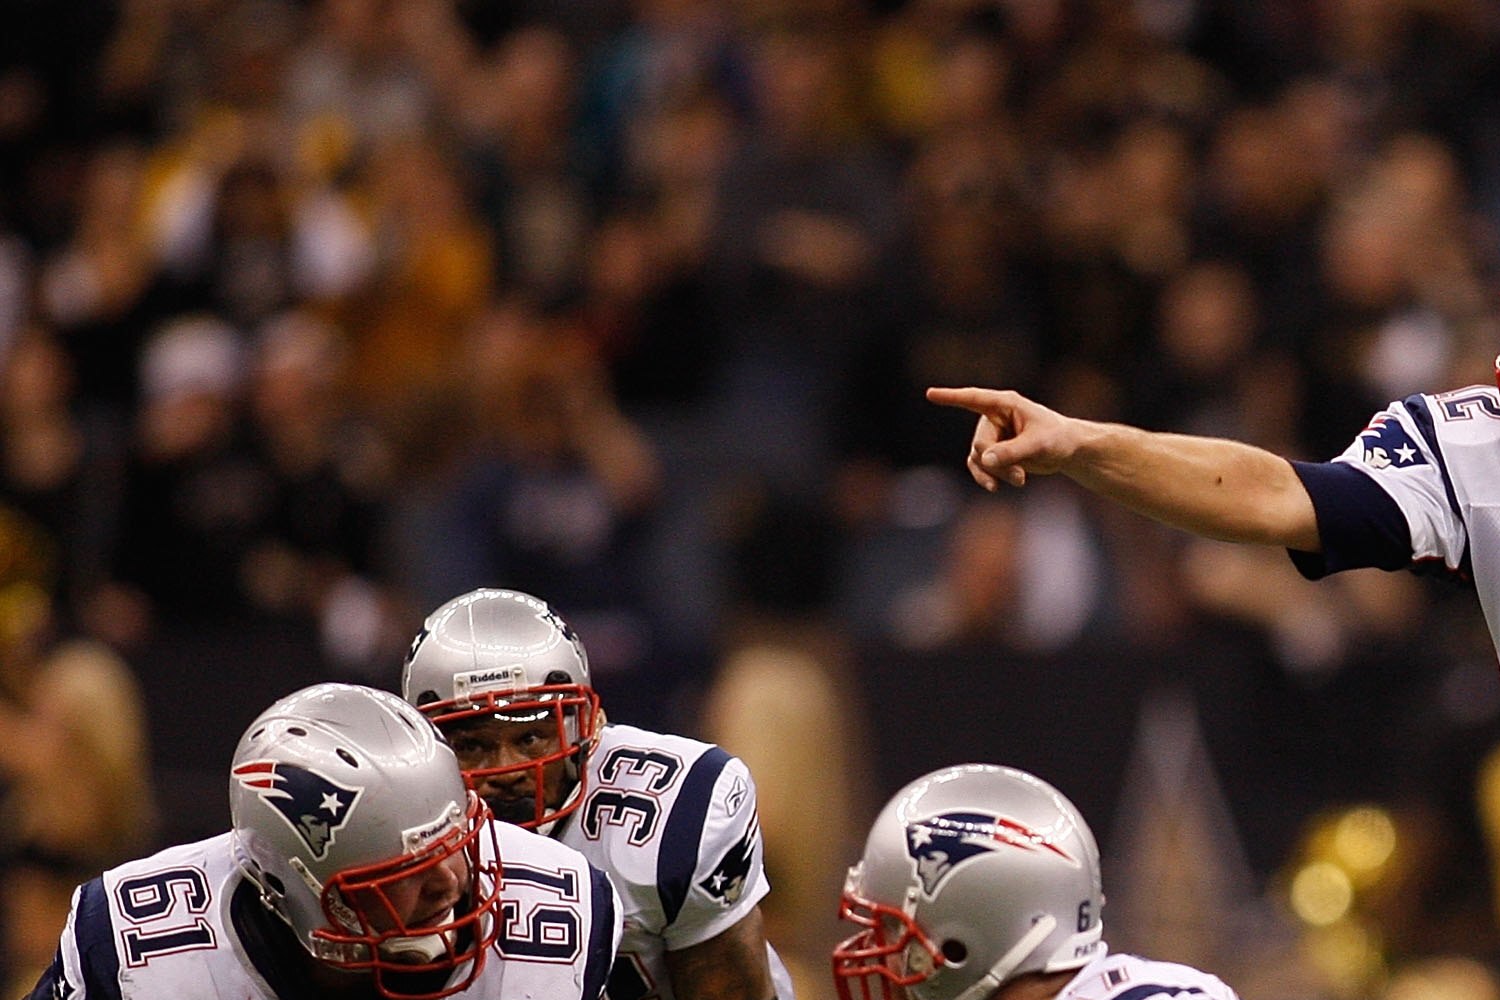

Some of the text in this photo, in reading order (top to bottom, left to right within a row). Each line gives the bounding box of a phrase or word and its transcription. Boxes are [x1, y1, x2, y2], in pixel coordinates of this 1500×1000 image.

[470, 670, 510, 684] Riddell
[580, 744, 685, 848] 33
[113, 865, 218, 969] 61
[488, 859, 582, 967] 61
